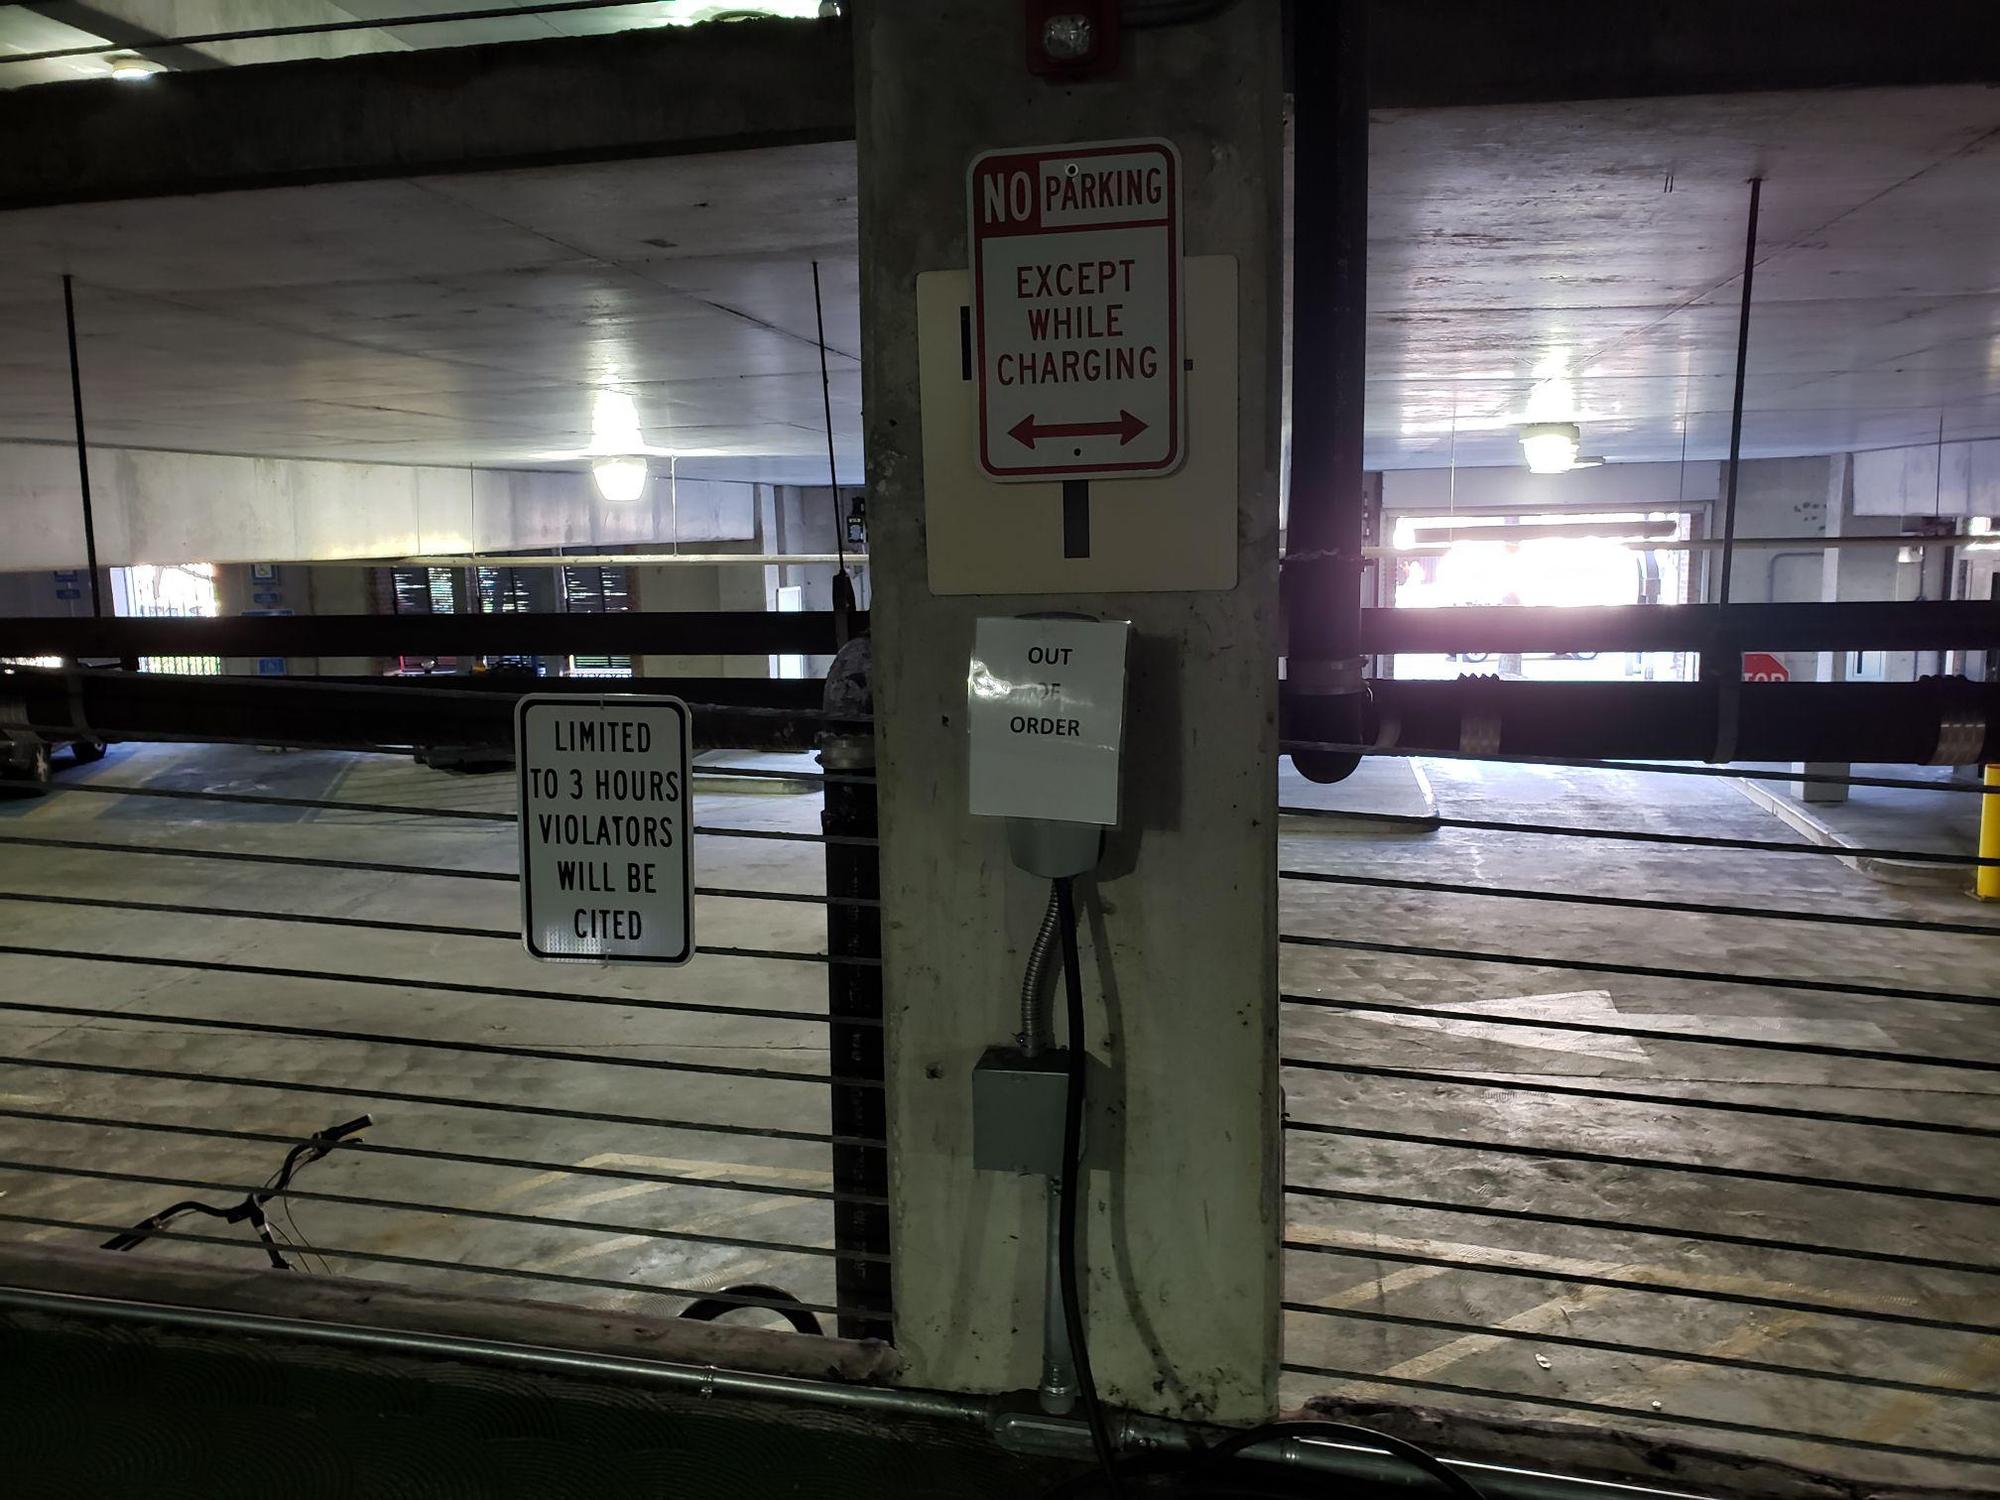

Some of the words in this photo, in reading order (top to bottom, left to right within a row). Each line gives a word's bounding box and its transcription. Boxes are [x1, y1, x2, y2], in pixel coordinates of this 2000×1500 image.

[983, 170, 1032, 224] NO
[1046, 167, 1162, 211] PARKING
[1016, 259, 1135, 299] EXCEPT
[1027, 304, 1123, 341] WHILE
[997, 346, 1158, 386] CHARGING
[1028, 647, 1073, 666] OUT
[554, 720, 651, 753] LIMITED
[1010, 716, 1080, 736] ORDER
[530, 768, 558, 799] TO
[569, 768, 583, 800] 3
[596, 769, 679, 802] HOURS
[538, 814, 673, 848] VIOLATORS
[557, 861, 616, 892] WILL
[627, 862, 657, 894] BE
[574, 908, 642, 941] CITED
